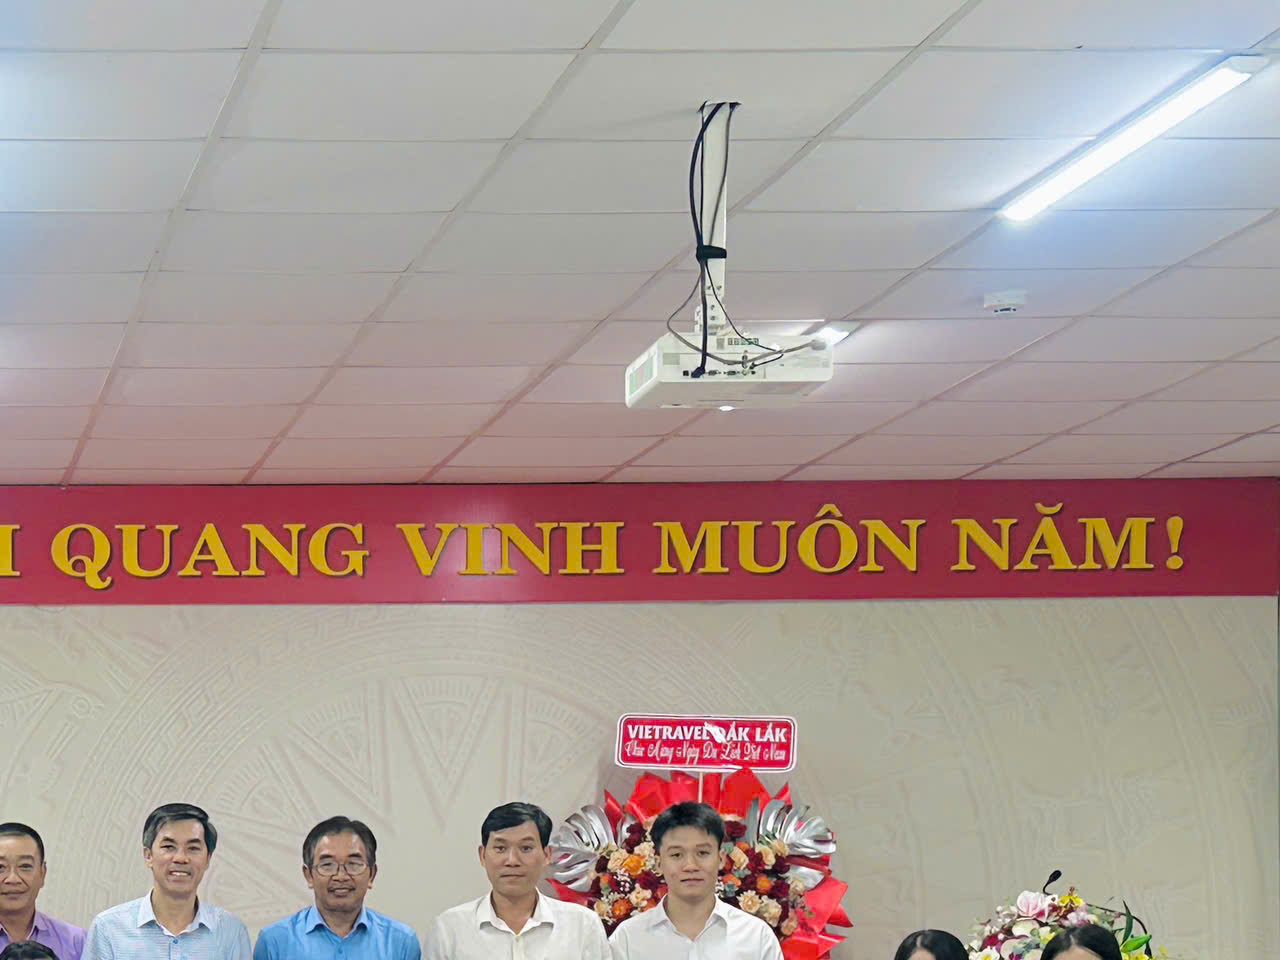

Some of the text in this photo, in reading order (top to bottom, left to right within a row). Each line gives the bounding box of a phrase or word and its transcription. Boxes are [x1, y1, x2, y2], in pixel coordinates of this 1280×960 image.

[50, 522, 369, 590] QUANG
[396, 521, 625, 576] VINH
[651, 503, 926, 573] MUÔN
[950, 502, 1185, 571] NĂM!
[627, 724, 710, 740] VIETRAVEL
